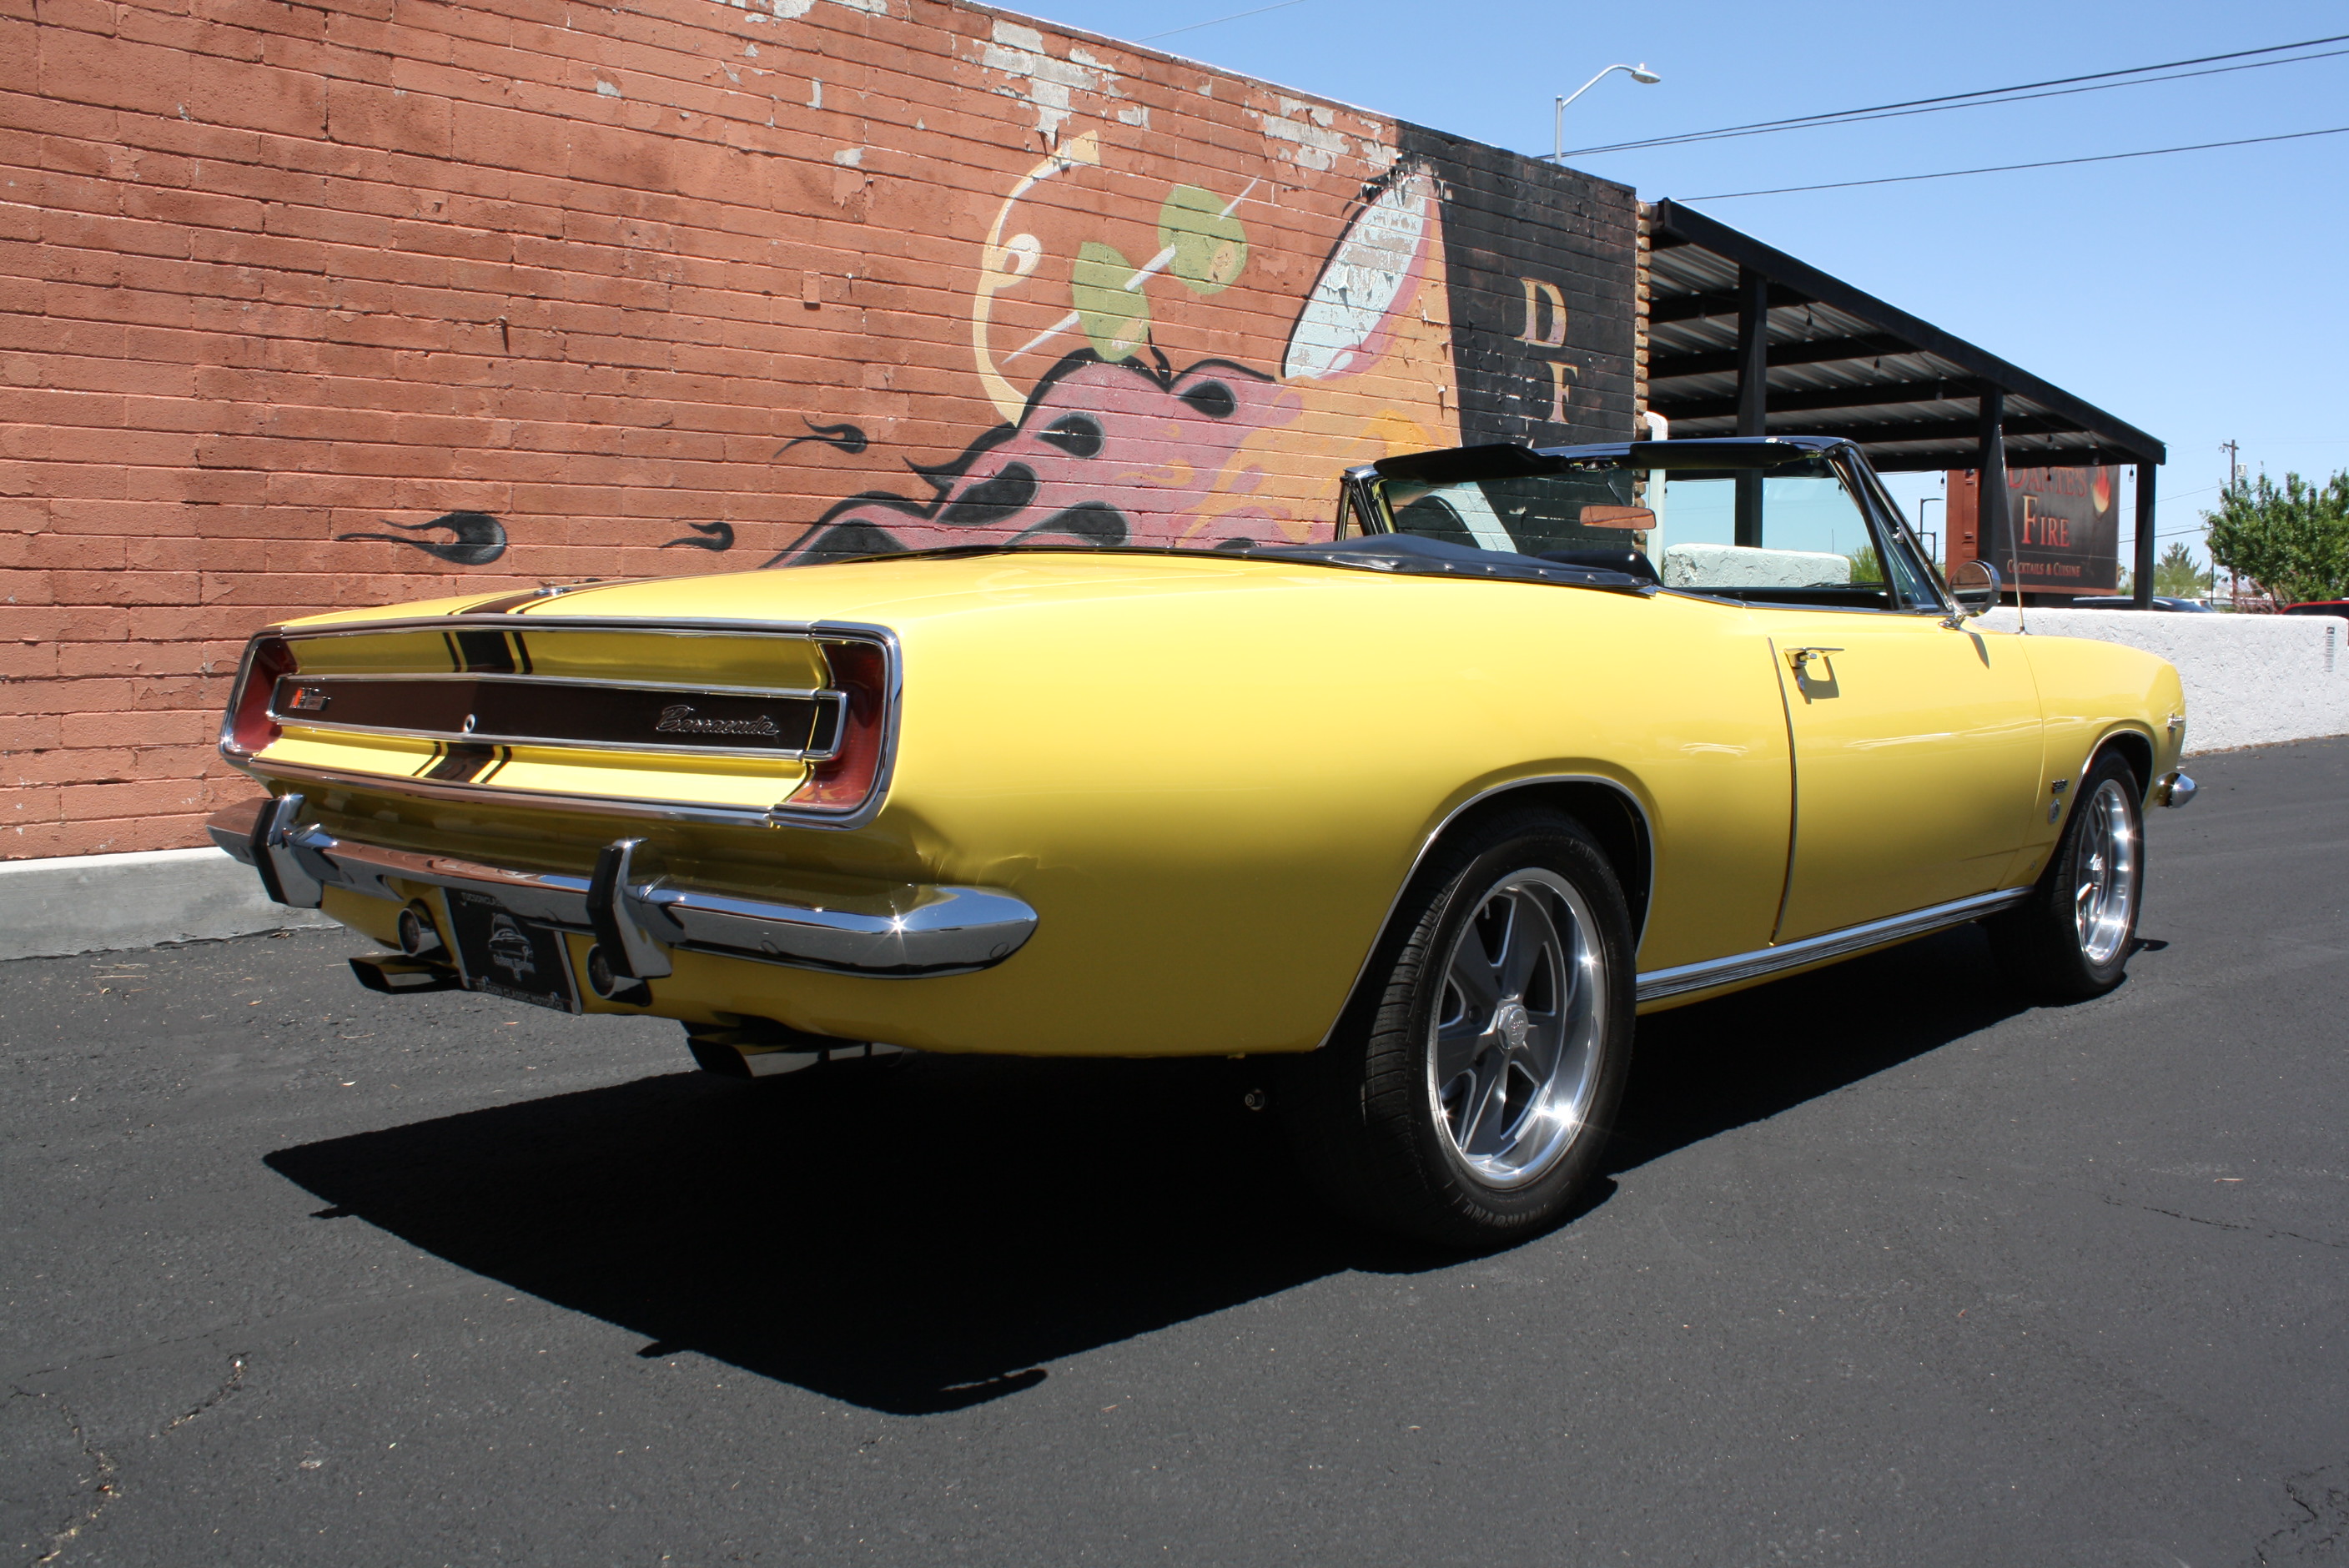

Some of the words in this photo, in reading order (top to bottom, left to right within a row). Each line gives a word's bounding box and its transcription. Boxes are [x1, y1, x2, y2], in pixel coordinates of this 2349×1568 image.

[1514, 277, 1567, 349] D
[1546, 361, 1578, 424] F
[2022, 495, 2070, 547] FIRE
[2007, 560, 2044, 575] CCKTAILS
[656, 705, 780, 736] Barracuda
